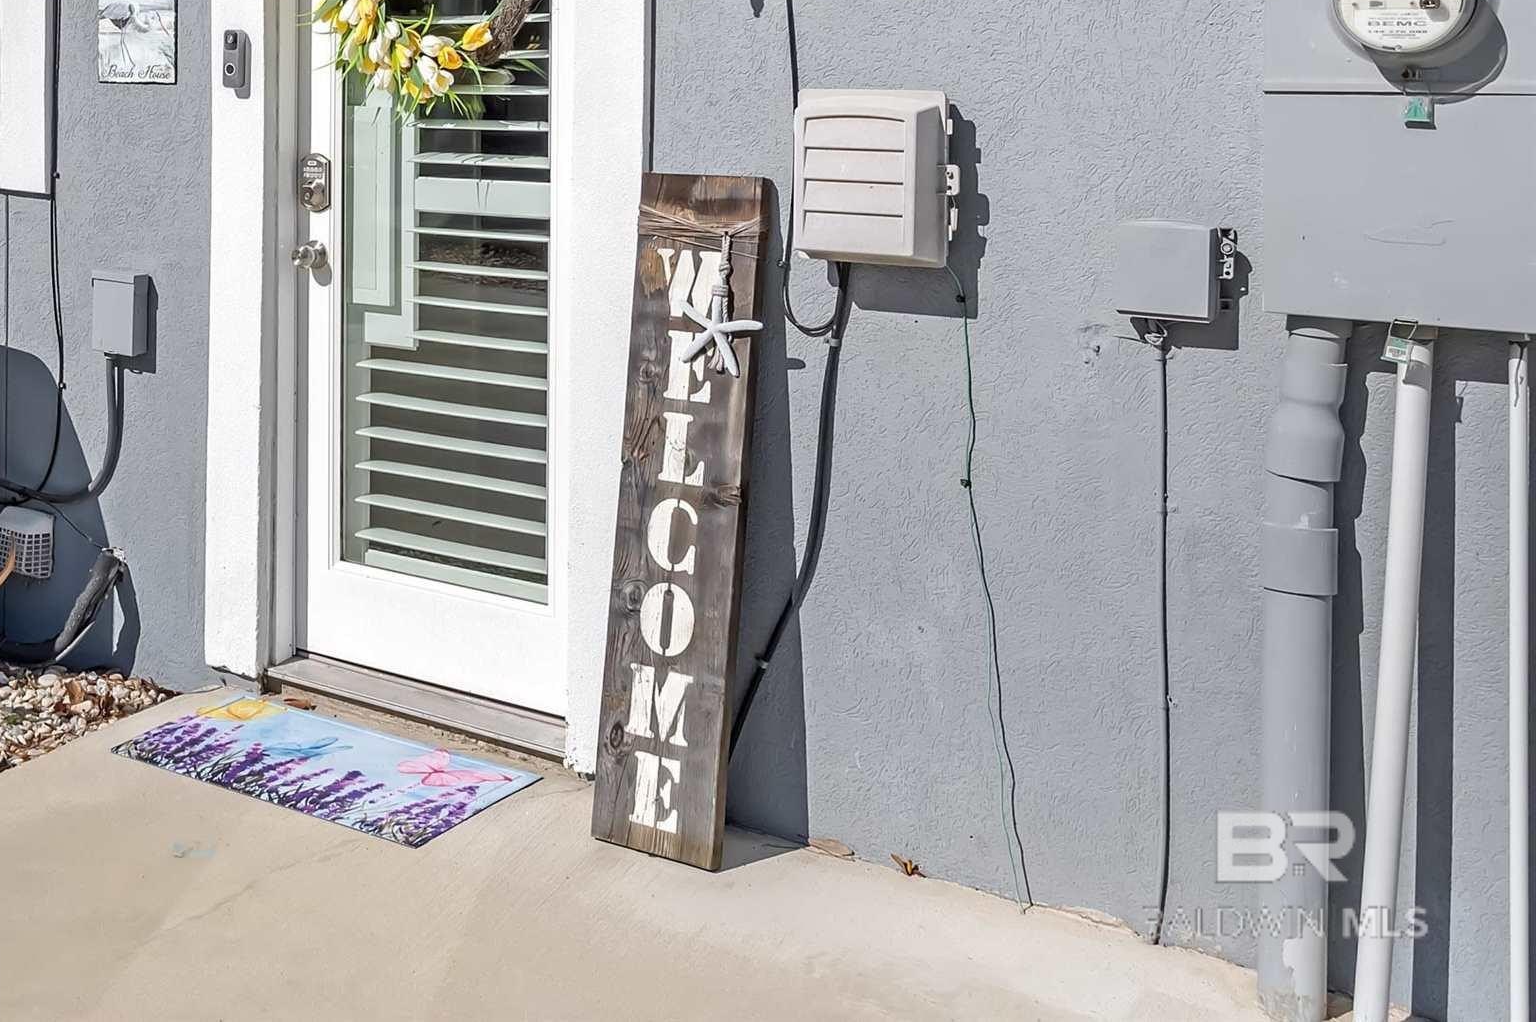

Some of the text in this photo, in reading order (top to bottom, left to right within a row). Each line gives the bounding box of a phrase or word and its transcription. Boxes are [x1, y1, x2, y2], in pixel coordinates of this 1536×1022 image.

[101, 64, 170, 79] Beach House
[625, 247, 724, 835] WELCOME
